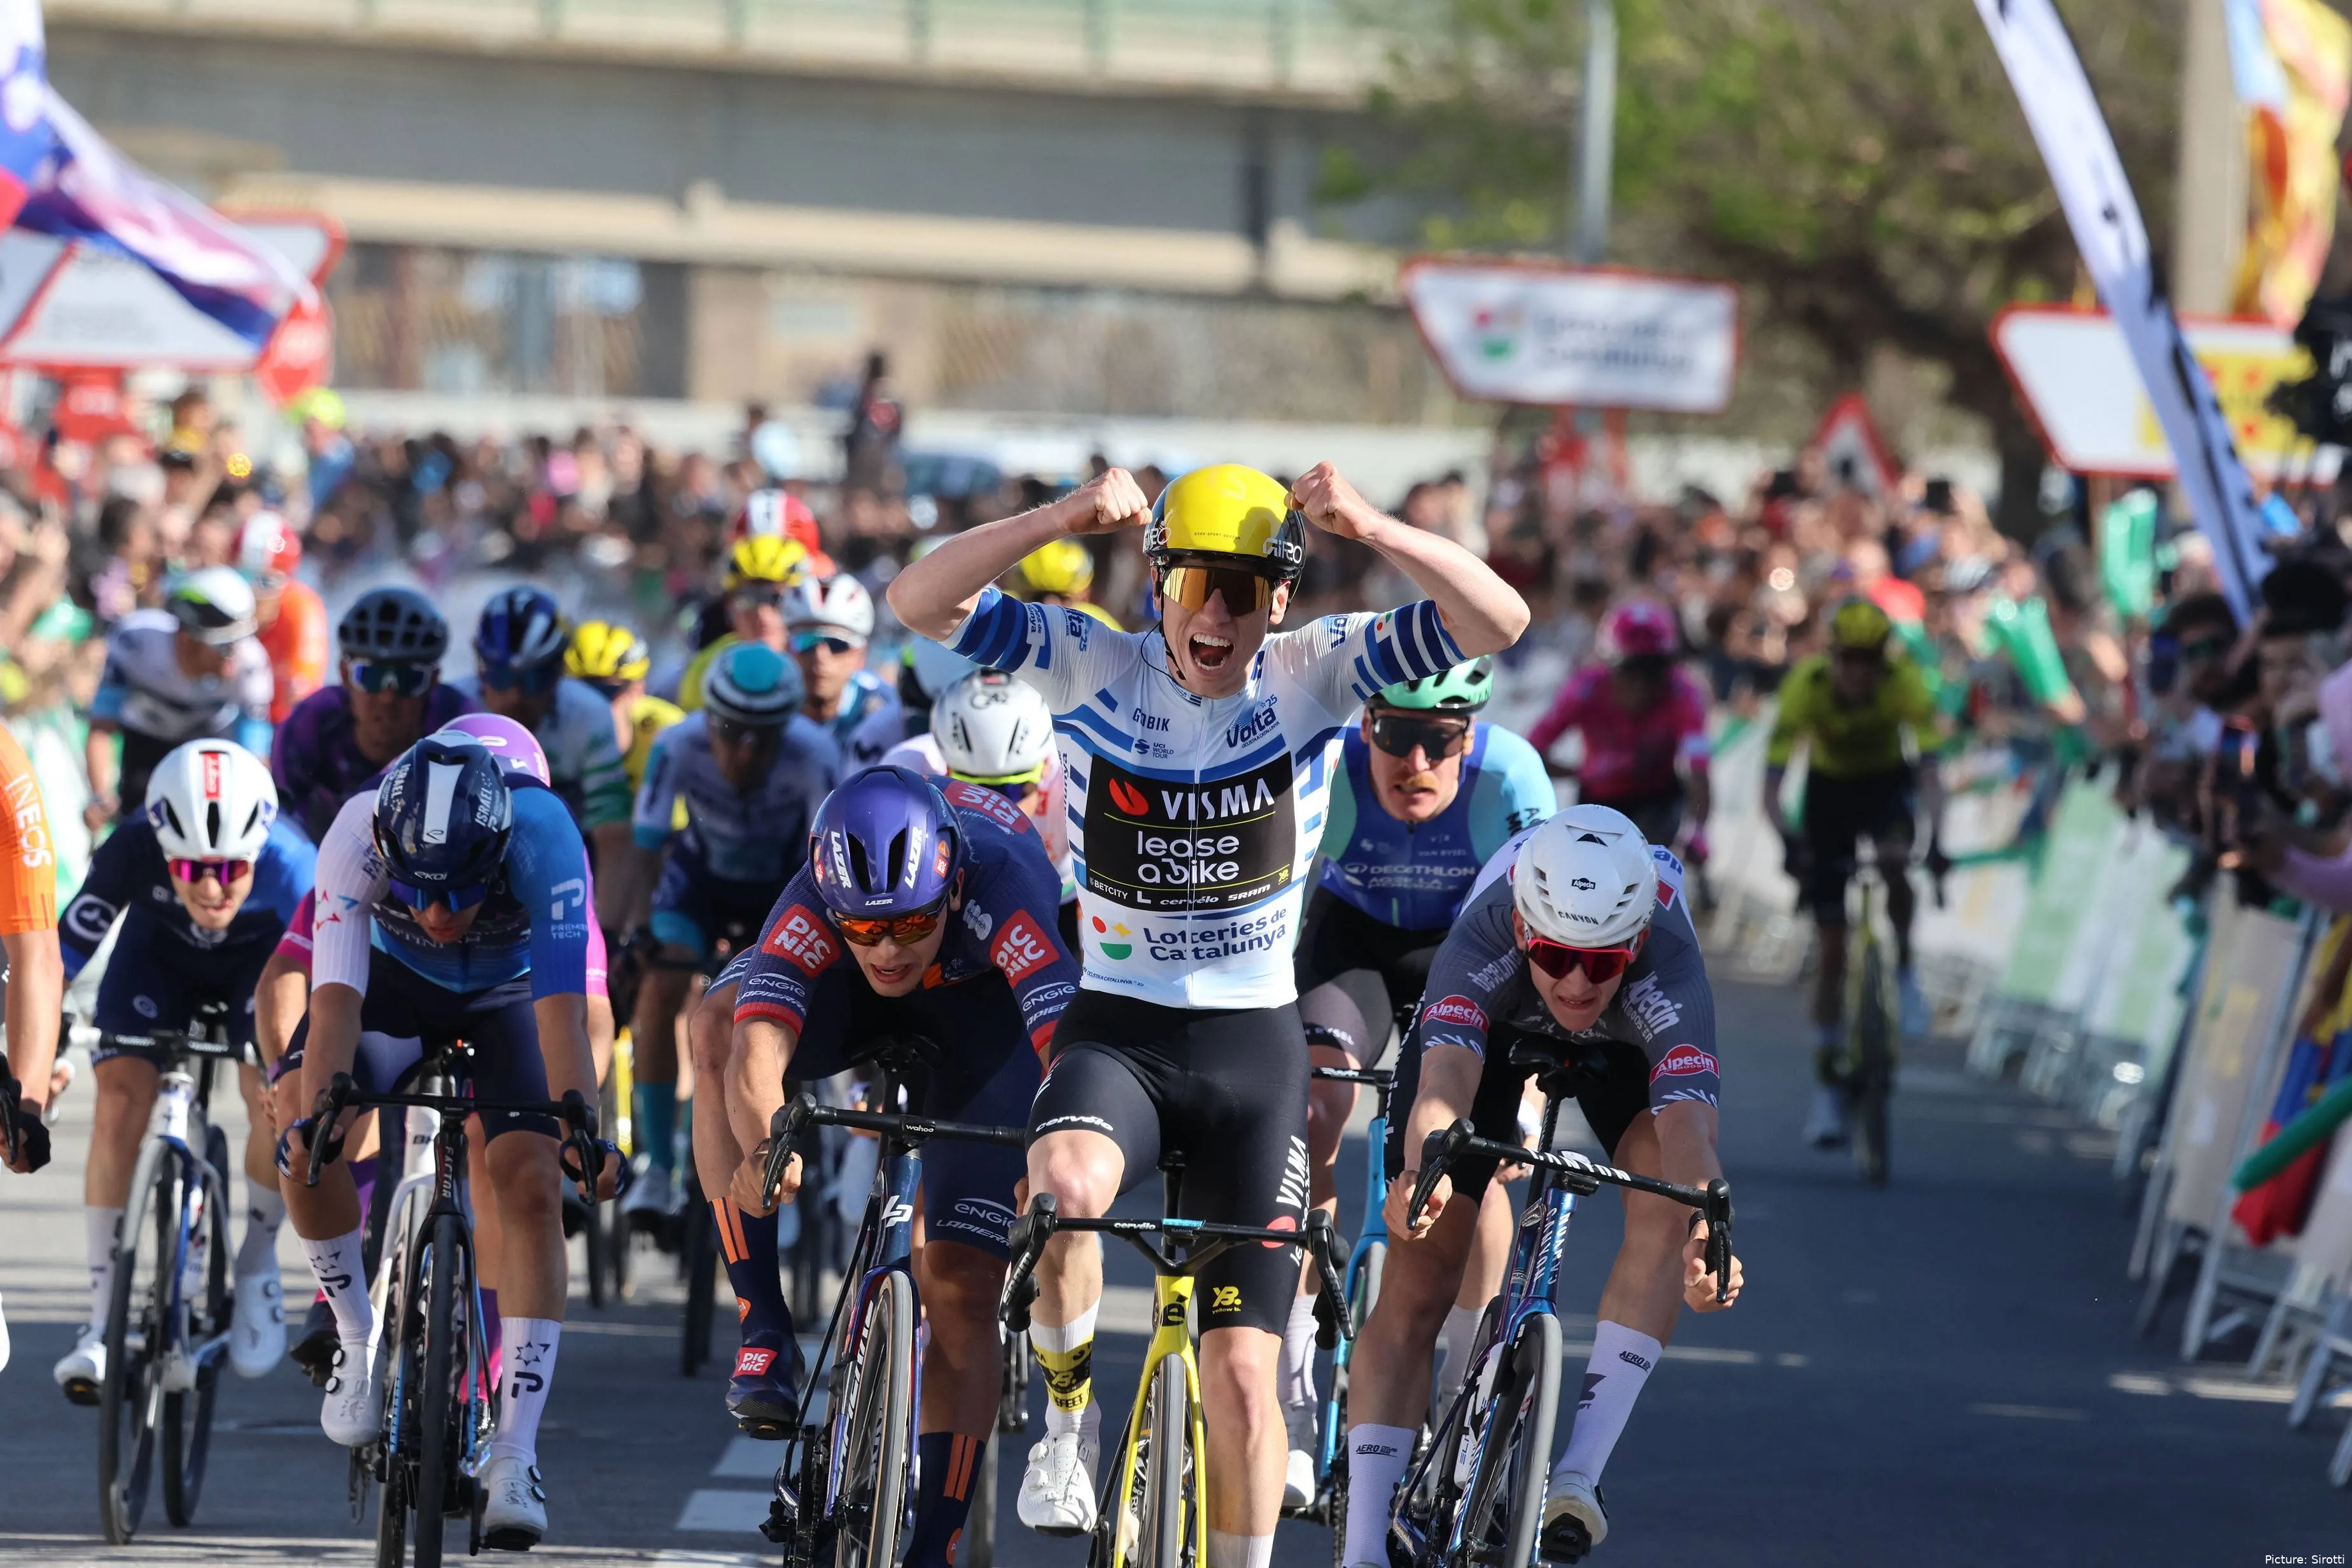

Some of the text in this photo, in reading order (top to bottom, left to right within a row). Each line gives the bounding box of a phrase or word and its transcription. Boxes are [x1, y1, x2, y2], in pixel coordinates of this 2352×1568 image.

[1263, 538, 1302, 563] GIRO
[1133, 708, 1170, 732] GOBIK
[1226, 708, 1277, 748] Volta
[1152, 746, 1174, 755] WORLD
[474, 787, 491, 827] ISRAEL
[1161, 777, 1275, 822] VISMA
[4, 773, 52, 868] INEOS
[1137, 830, 1240, 857] lease
[830, 831, 852, 889] LAZER
[905, 826, 923, 890] LAZER
[1370, 865, 1476, 877] DECATHLON
[1094, 879, 1128, 899] BETCITY
[1228, 883, 1271, 902] SRAM
[1572, 879, 1595, 889] Alpecin
[1159, 895, 1219, 906] cervélo
[551, 923, 589, 932] PREMIE
[1143, 907, 1287, 946] Loteries de
[1558, 911, 1599, 925] CANYON
[552, 931, 581, 940] TECH
[786, 915, 831, 962] PIC
[996, 924, 1032, 968] PIC
[1149, 924, 1287, 962] Catalunya
[736, 990, 807, 1017] LAPIERR
[1426, 1004, 1484, 1028] Alpecin
[1655, 1054, 1714, 1079] Alpecin
[906, 1124, 934, 1133] wahoo
[1035, 1116, 1114, 1133] cervélo
[442, 1145, 454, 1198] FACTOR
[1275, 1135, 1306, 1209] VISMA
[1525, 1147, 1632, 1182] CANYON
[935, 1219, 1012, 1247] LAPIERR
[1532, 1207, 1557, 1283] CANYON
[1002, 1251, 1033, 1305] SRAM
[1326, 1268, 1349, 1322] SRAM
[743, 1352, 769, 1362] PIC
[1619, 1350, 1645, 1365] AERO
[1355, 1444, 1380, 1452] AERO
